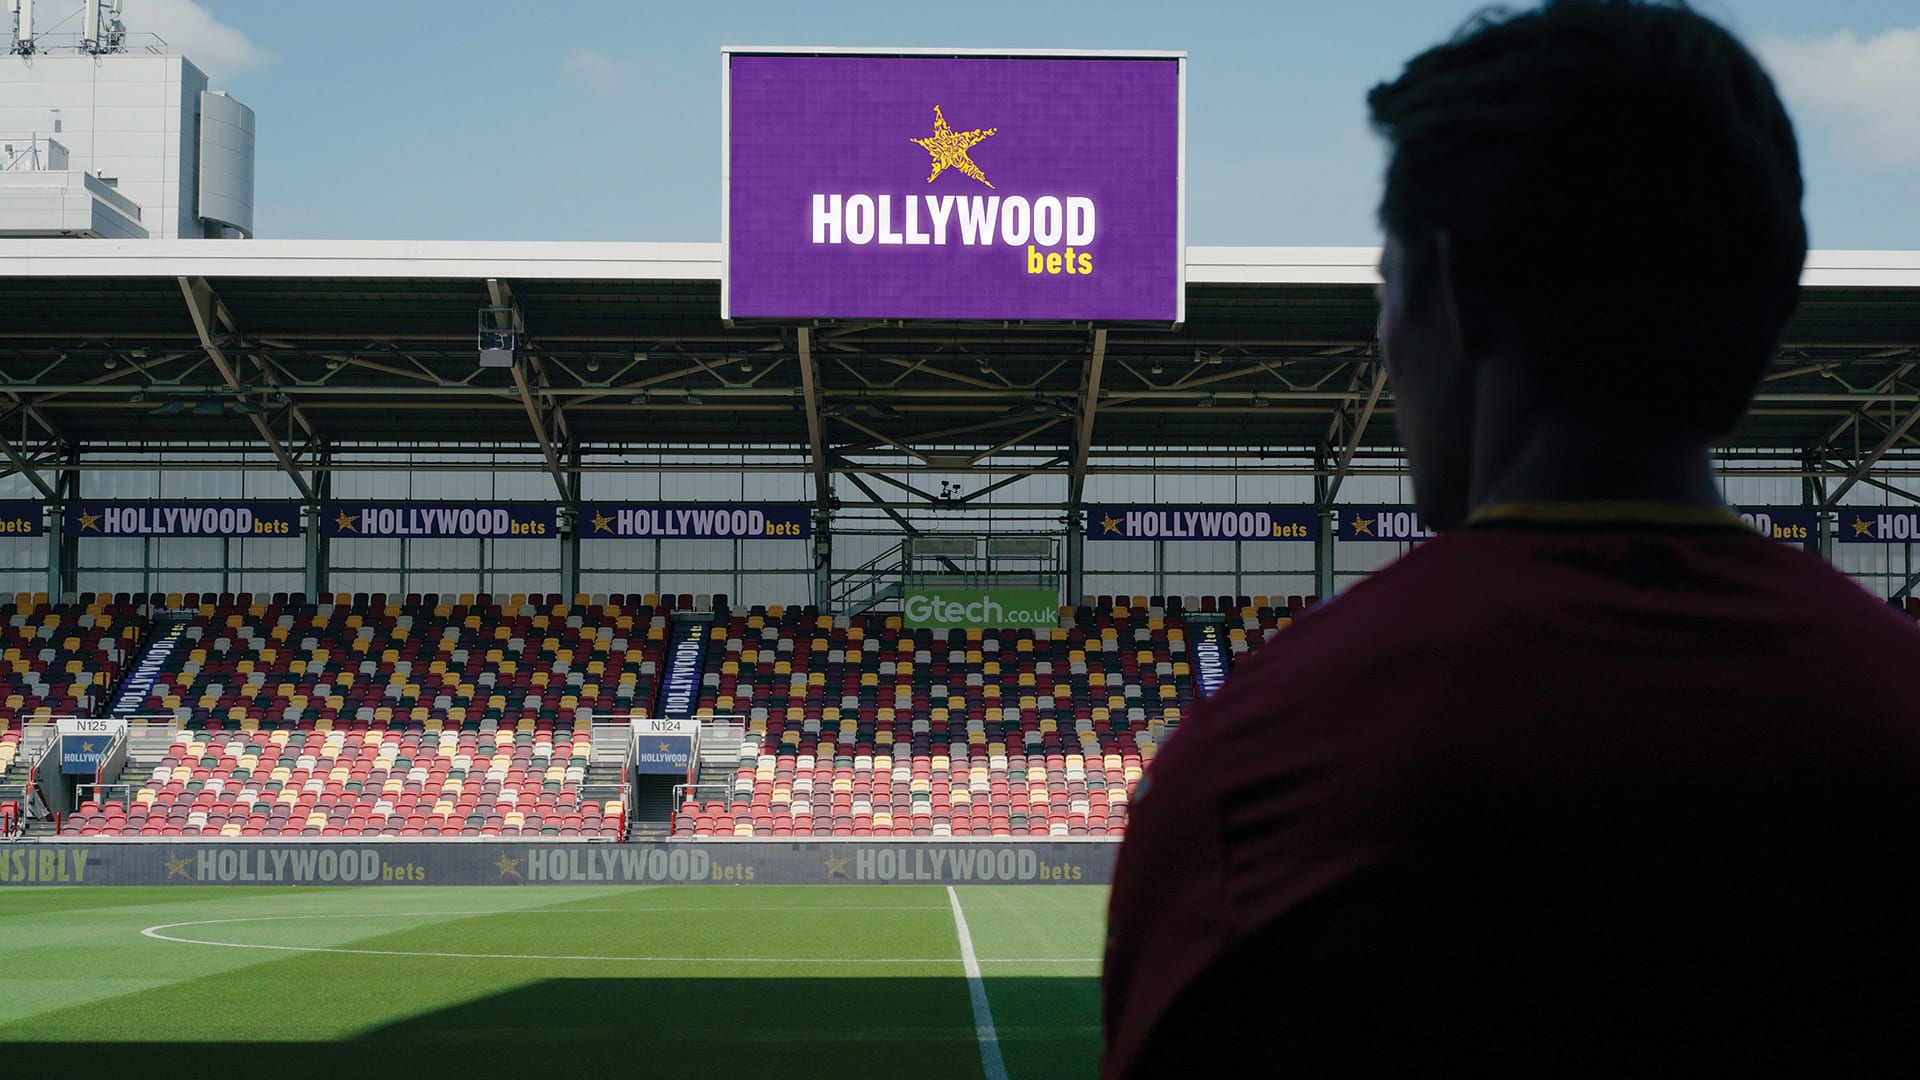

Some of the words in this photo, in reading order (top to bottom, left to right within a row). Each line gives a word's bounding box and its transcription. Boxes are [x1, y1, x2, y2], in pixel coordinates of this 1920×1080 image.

[812, 194, 1096, 247] HOLLYWOOD
[1027, 245, 1093, 274] bets
[104, 507, 252, 534] HOLLYWOOD
[254, 518, 289, 534] bets
[361, 508, 509, 535] HOLLYWOOD
[511, 519, 546, 535] bets
[618, 509, 764, 536] HOLLYWOOD
[765, 519, 801, 536] bets
[1126, 511, 1271, 537] HOLLYWOOD
[1272, 522, 1307, 537] bets
[1773, 523, 1808, 539] bets
[77, 721, 107, 731] N125
[651, 721, 681, 731] N124
[641, 753, 688, 763] HOLLYWOOD
[197, 849, 380, 881] HOLLYWOOD
[382, 863, 426, 881] bets
[528, 849, 710, 881] HOLLYWOOD
[712, 862, 755, 881] bets
[857, 848, 1037, 880] HOLLYWOOD
[1039, 862, 1082, 880] bets
